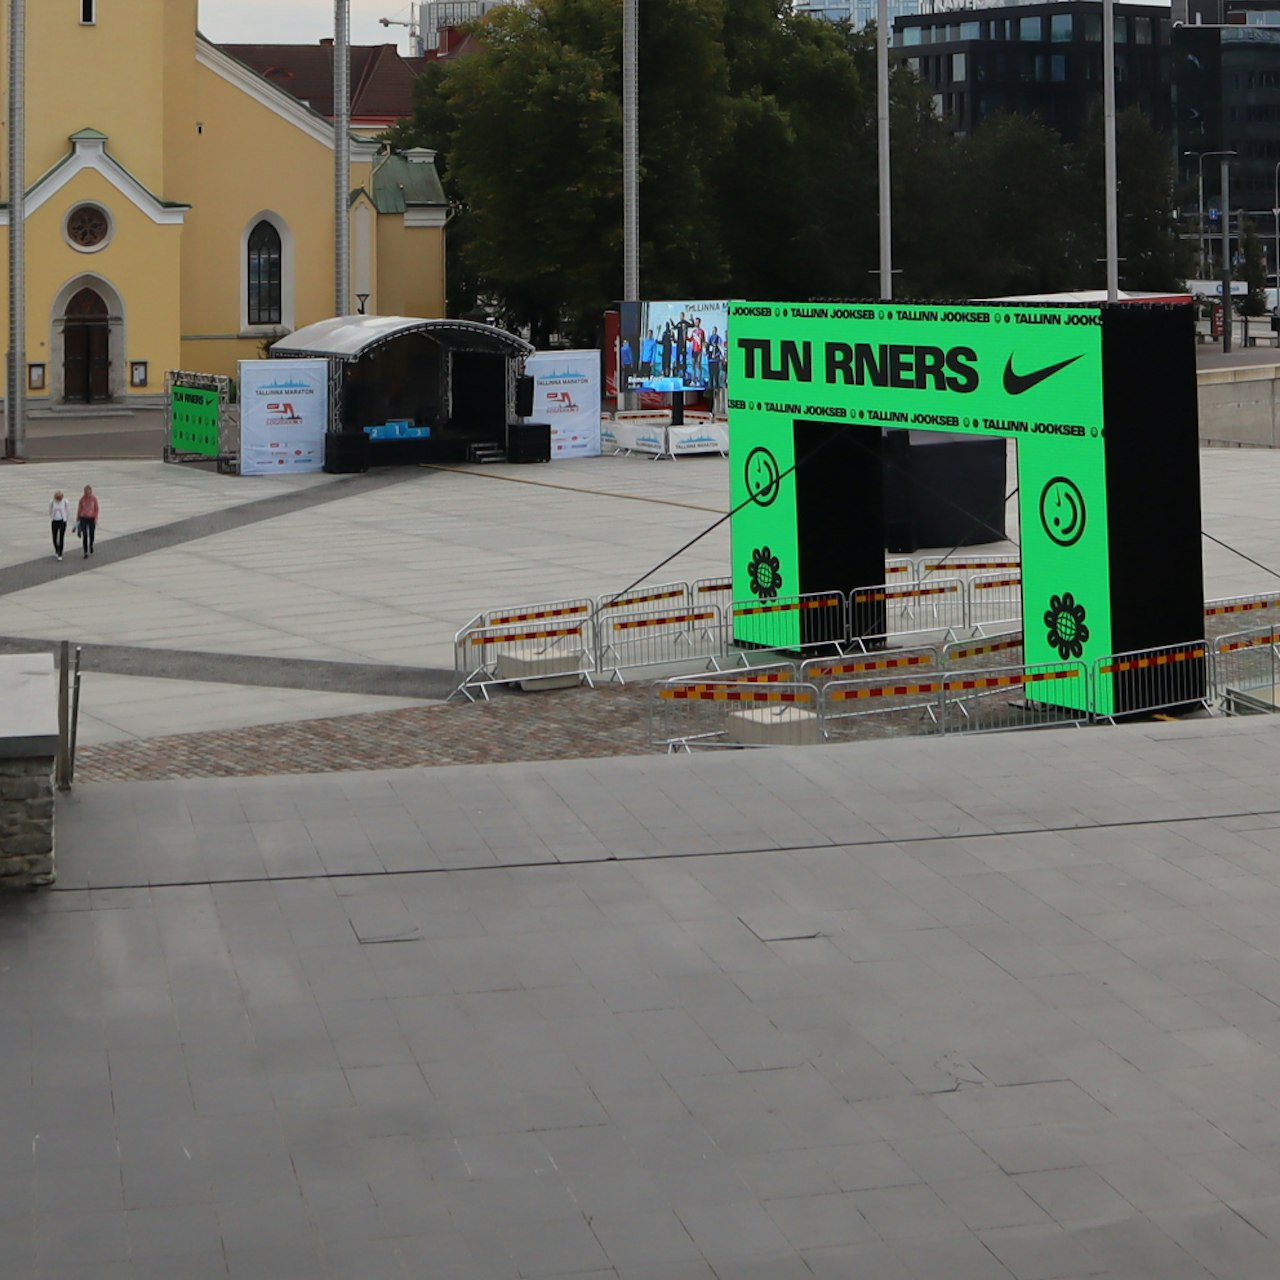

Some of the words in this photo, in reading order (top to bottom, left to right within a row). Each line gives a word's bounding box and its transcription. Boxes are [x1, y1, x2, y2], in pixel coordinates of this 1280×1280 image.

[732, 307, 772, 316] JOOKSEB
[791, 308, 828, 318] TALLINN
[830, 309, 875, 320] JOOKSEB
[896, 310, 938, 322] TALLINN
[940, 312, 990, 323] JOOKSEB
[1014, 314, 1061, 325] TALLINN
[738, 338, 812, 382] TLN
[825, 342, 979, 394] RNERS
[764, 402, 802, 414] TALLINN
[803, 406, 847, 418] JOOKSEB
[867, 409, 908, 422] TALLINN
[910, 413, 959, 427] JOOKSEB
[982, 418, 1028, 432] TALLINN
[1031, 422, 1086, 437] JOOKSEB
[372, 429, 378, 437] 2
